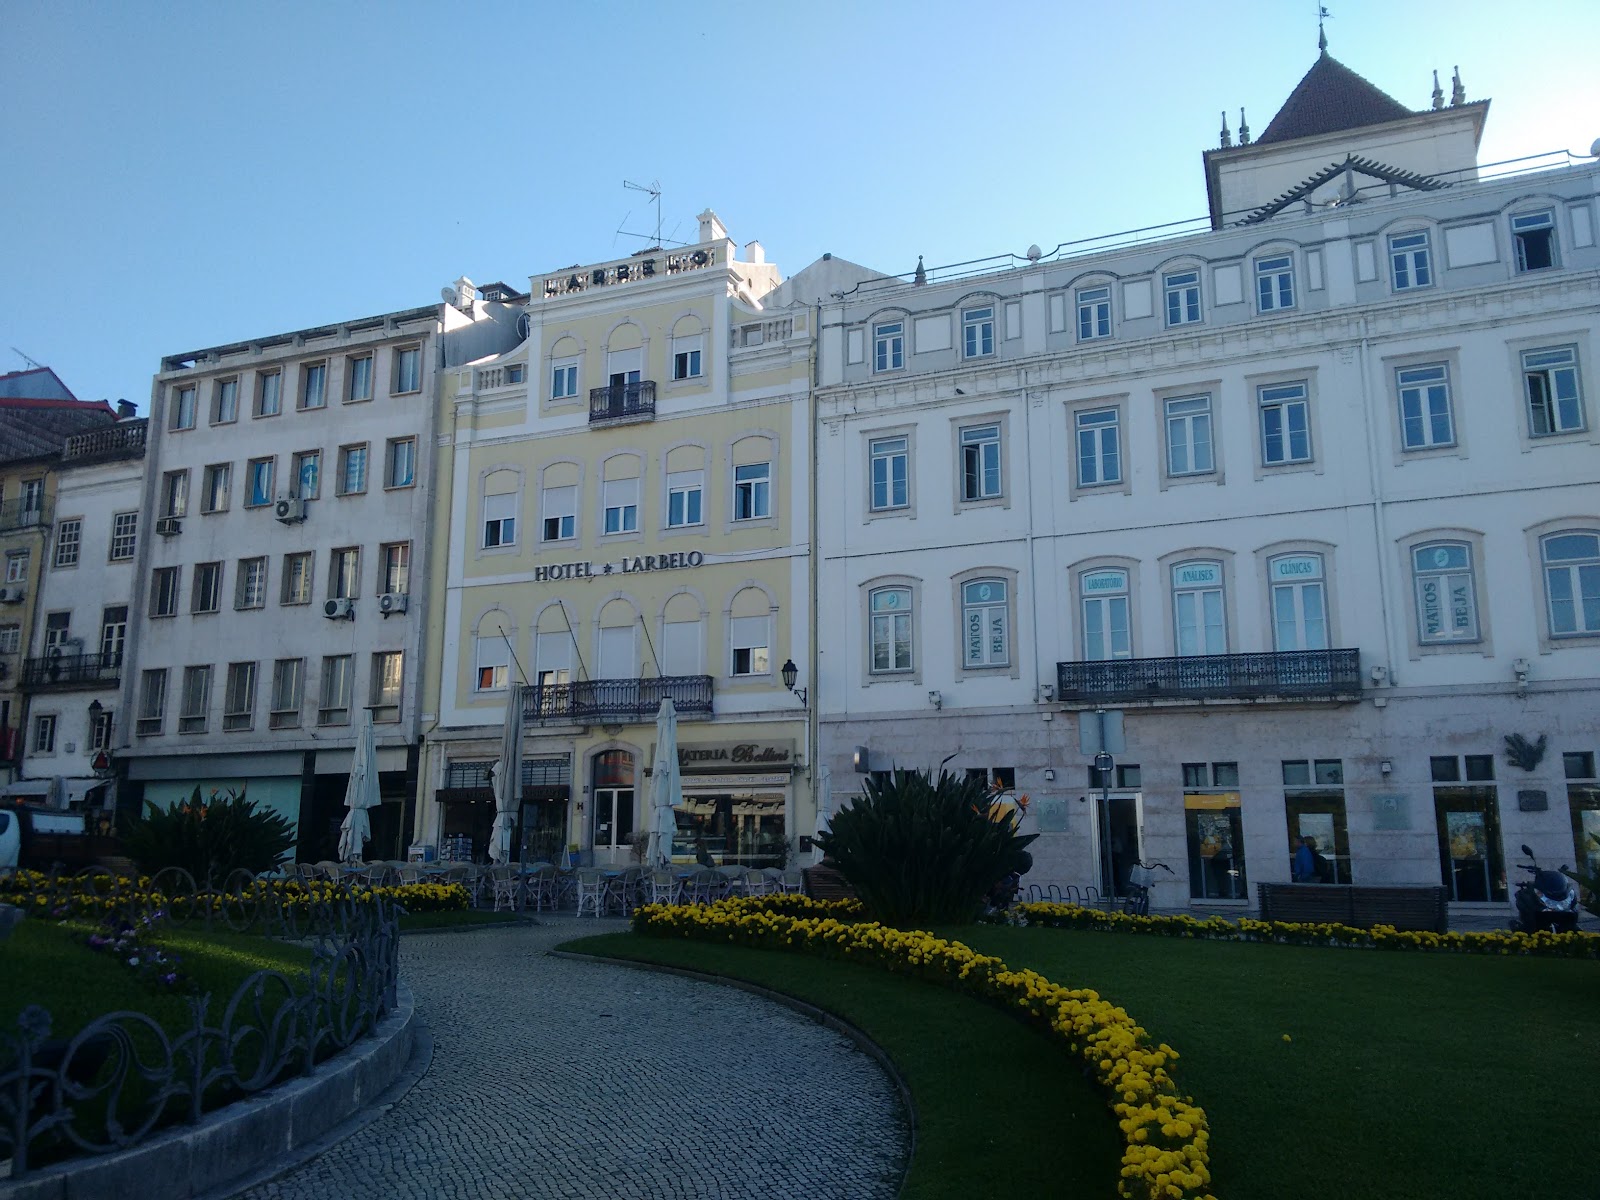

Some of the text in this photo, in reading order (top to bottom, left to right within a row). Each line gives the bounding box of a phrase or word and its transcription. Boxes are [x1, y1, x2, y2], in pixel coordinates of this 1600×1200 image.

[545, 250, 708, 294] LARBELO
[535, 551, 703, 582] HOTEL LARBELO
[1280, 560, 1312, 575] CLÍNICAS
[1424, 582, 1439, 634] MATOS
[1453, 586, 1469, 627] BEJA
[970, 614, 981, 658] MATOS
[993, 617, 1003, 652] BEJA
